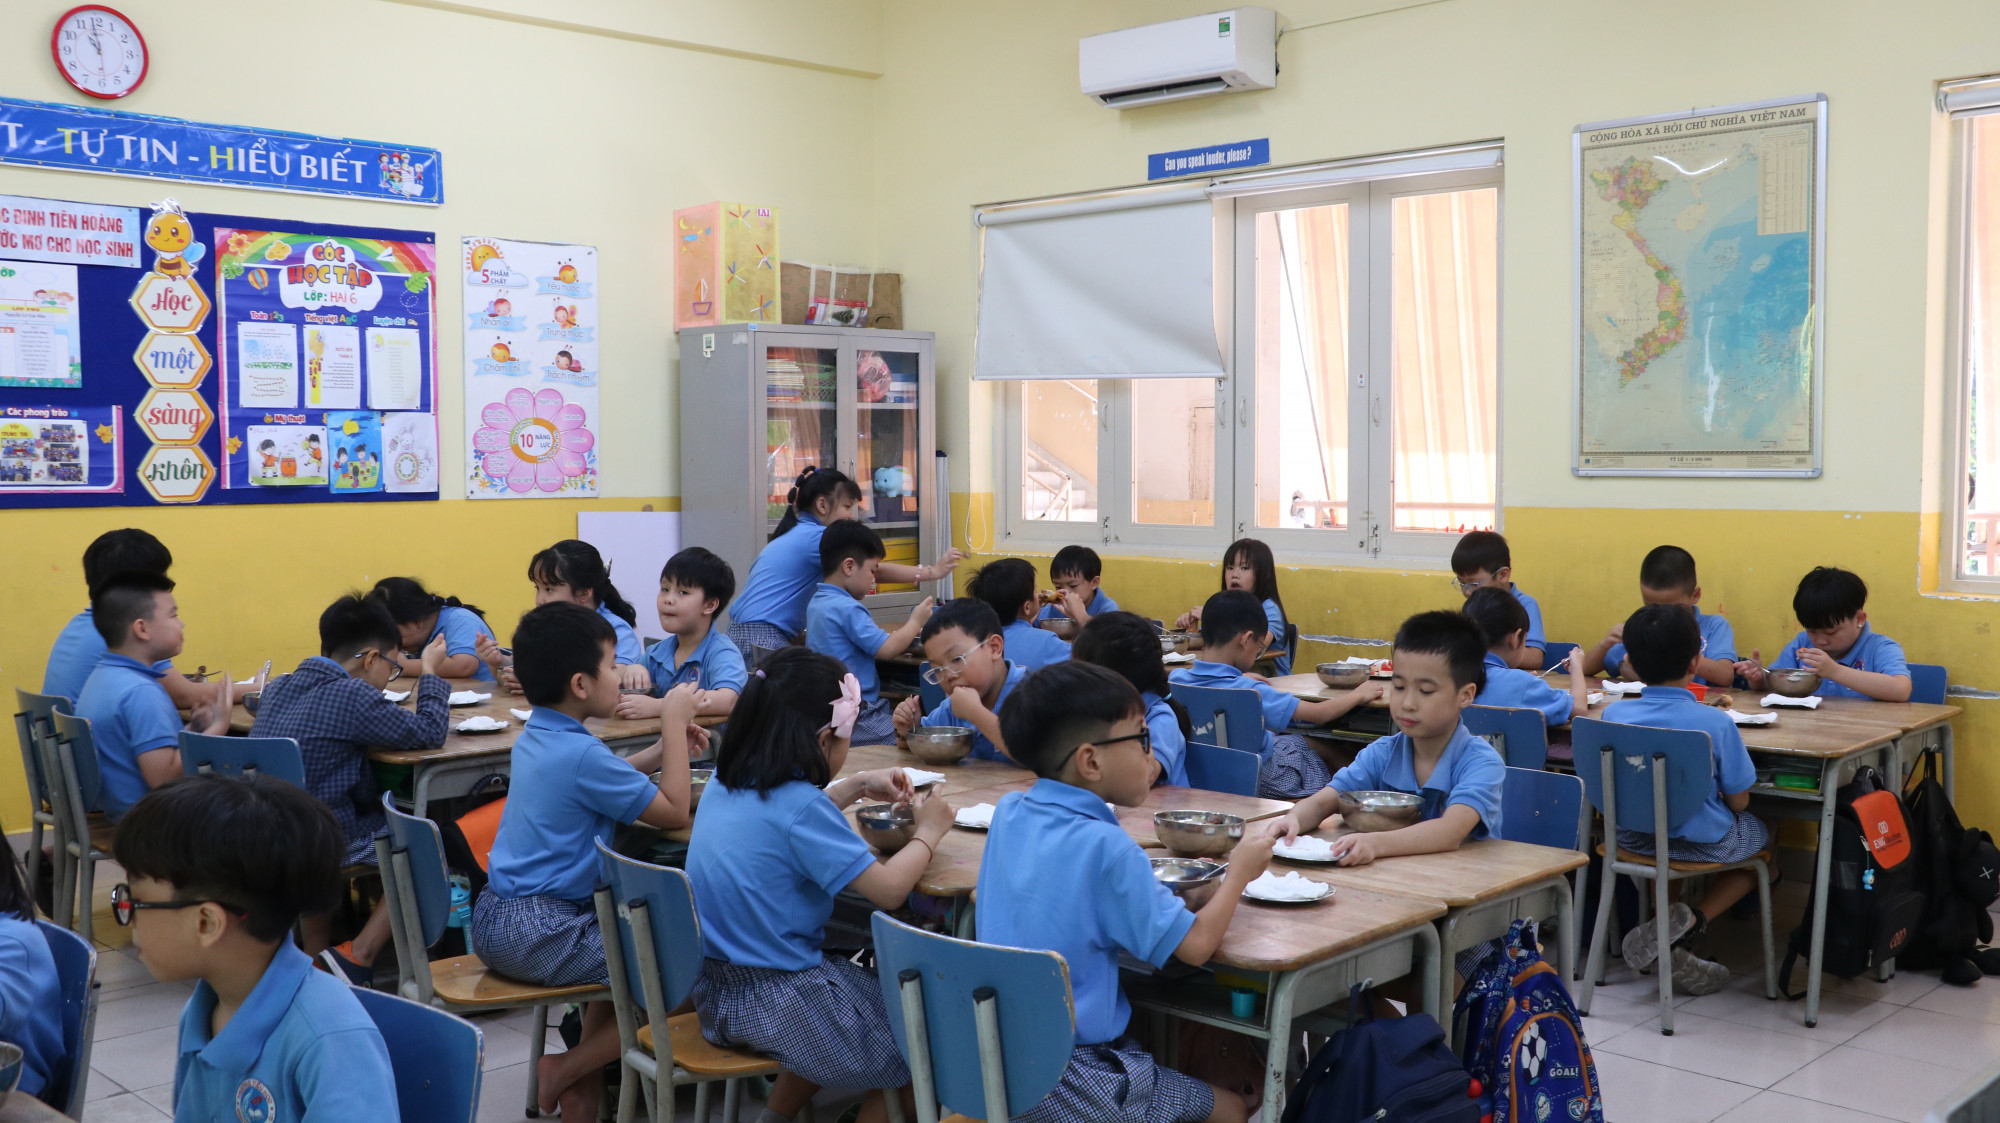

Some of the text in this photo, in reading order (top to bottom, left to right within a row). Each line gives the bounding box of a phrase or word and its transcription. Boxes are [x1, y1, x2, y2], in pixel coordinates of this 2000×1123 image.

[76, 19, 86, 29] 11
[90, 17, 103, 27] 12
[65, 31, 77, 41] 10
[121, 34, 128, 44] 2
[63, 46, 71, 55] 9
[126, 50, 134, 59] 3
[69, 61, 77, 71] 8
[123, 64, 131, 75] 4
[82, 74, 89, 83] 7
[98, 78, 106, 88] 6
[114, 76, 121, 85] 5
[1590, 107, 1806, 143] CỘNG HÒA XÃ HỘI CHỦ NGHĨA VIỆT NAM
[57, 128, 108, 165] TỰ
[117, 134, 178, 165] TIN
[209, 137, 291, 177] HIỂU
[301, 147, 367, 184] BIẾT
[1164, 157, 1176, 171] Can
[1176, 156, 1187, 171] you
[1188, 153, 1205, 169] speak
[1206, 150, 1226, 165] louder,
[1227, 148, 1247, 163] please
[13, 209, 45, 226] ĐINH
[50, 210, 77, 230] TIÊN
[82, 213, 123, 233] HOÀNG
[22, 234, 43, 251] MƠ
[47, 236, 72, 253] CHO
[76, 239, 102, 258] HỌC
[105, 240, 134, 258] SINH
[0, 267, 16, 278] ỚP
[287, 263, 373, 289] HỌC TẬP
[481, 269, 490, 283] 5
[151, 286, 194, 315] Học
[350, 292, 358, 304] 6
[269, 311, 285, 322] 123
[150, 347, 198, 374] một
[23, 408, 49, 419] phong
[148, 403, 201, 434] sàng
[520, 434, 533, 448] 10
[1549, 1067, 1579, 1078] GOAL!
